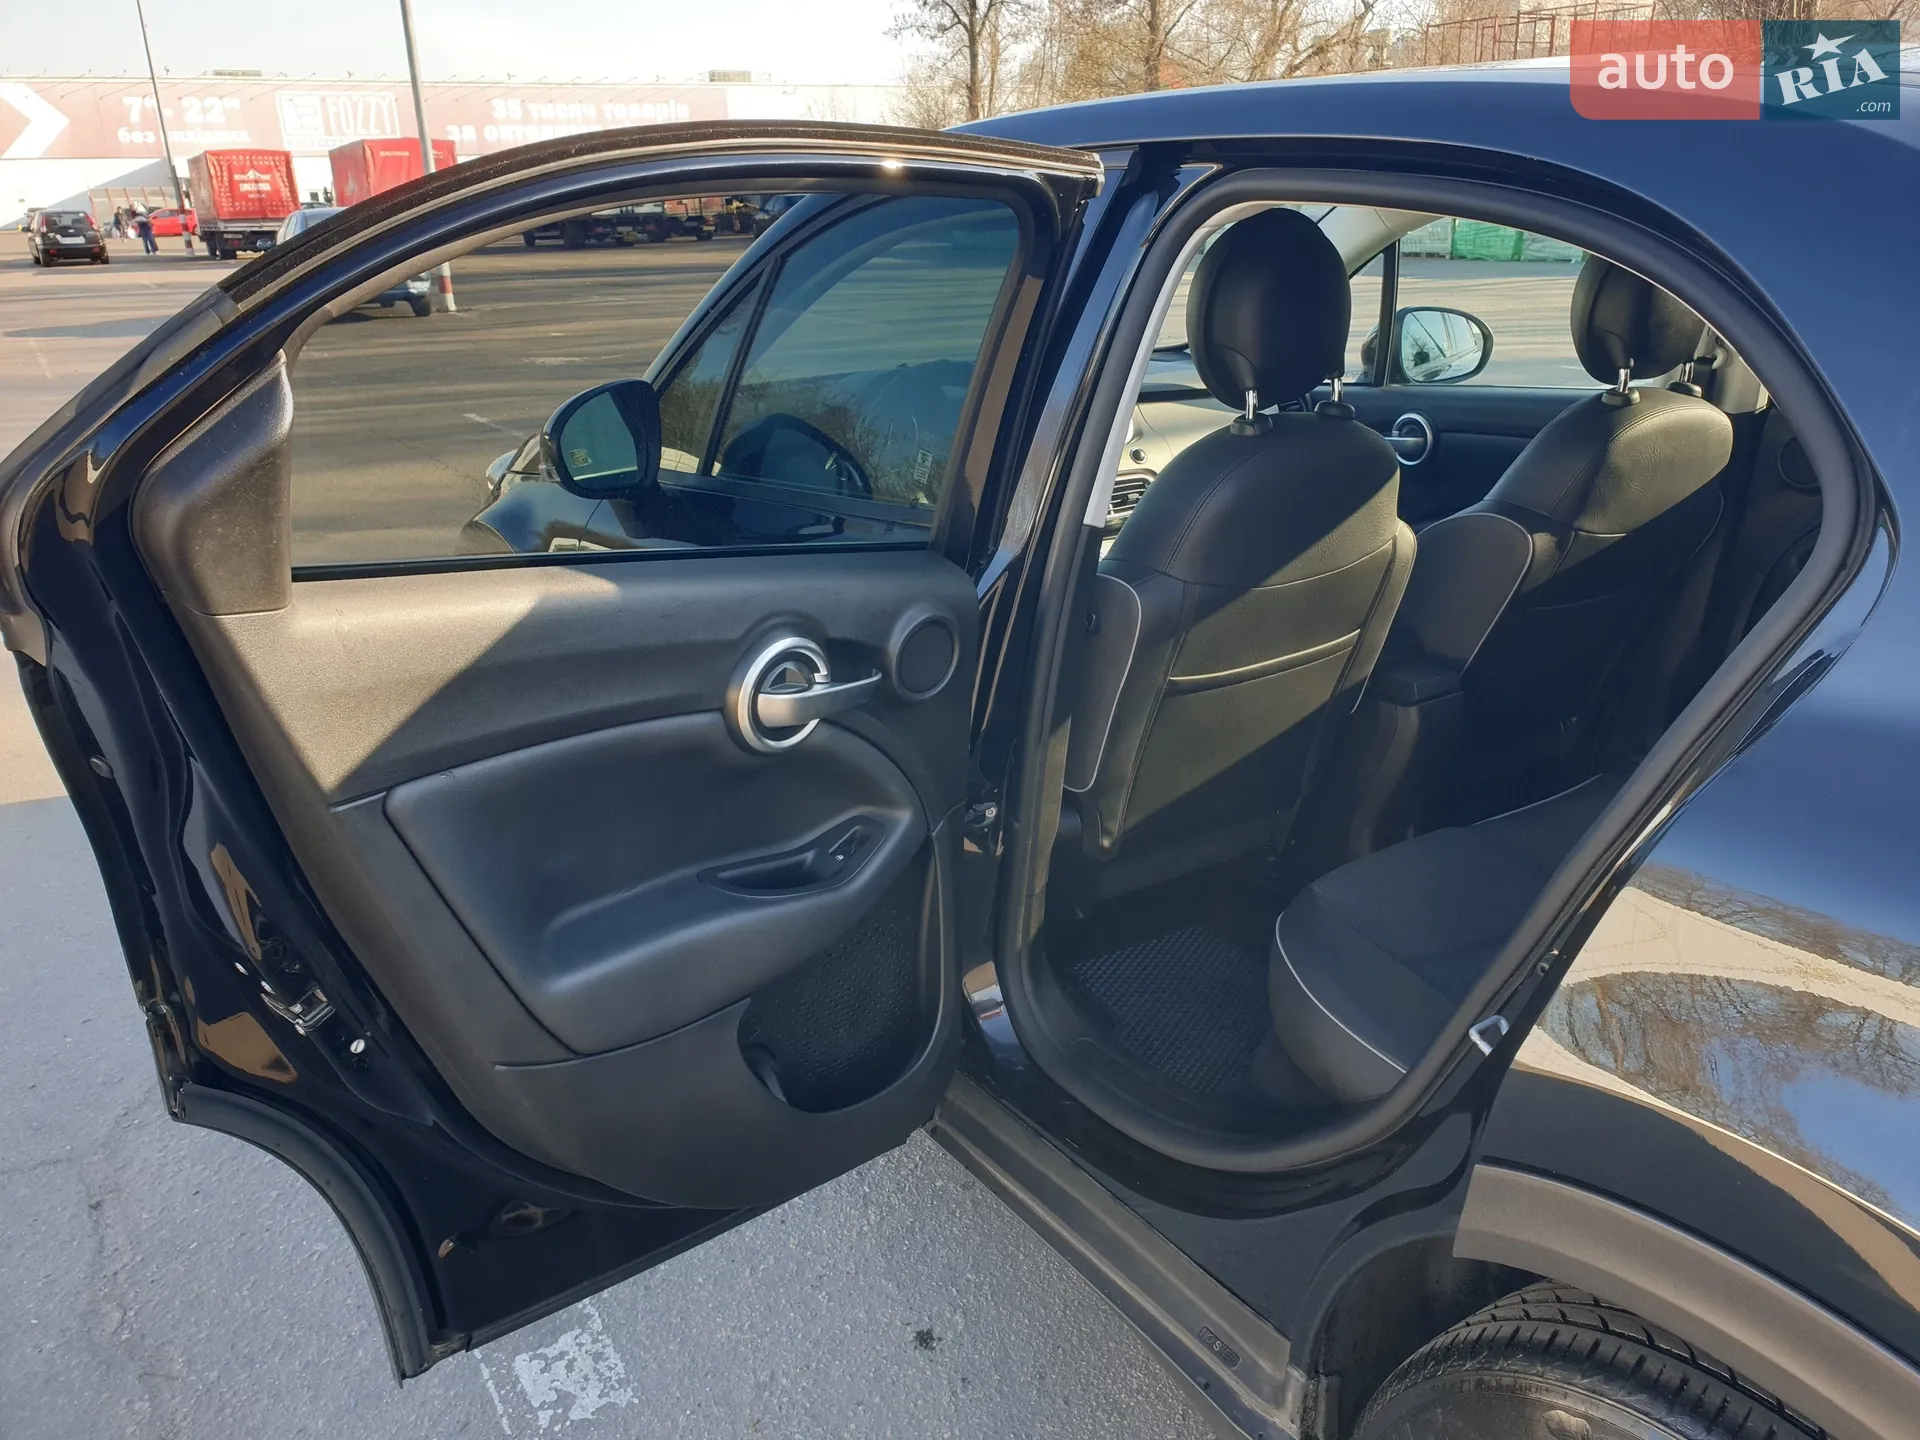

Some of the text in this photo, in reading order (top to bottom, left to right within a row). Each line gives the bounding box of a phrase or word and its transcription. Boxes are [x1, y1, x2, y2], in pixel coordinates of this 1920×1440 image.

[326, 95, 392, 136] FOZZY
[491, 97, 523, 120] 35
[118, 127, 156, 143] без
[446, 125, 476, 141] за
